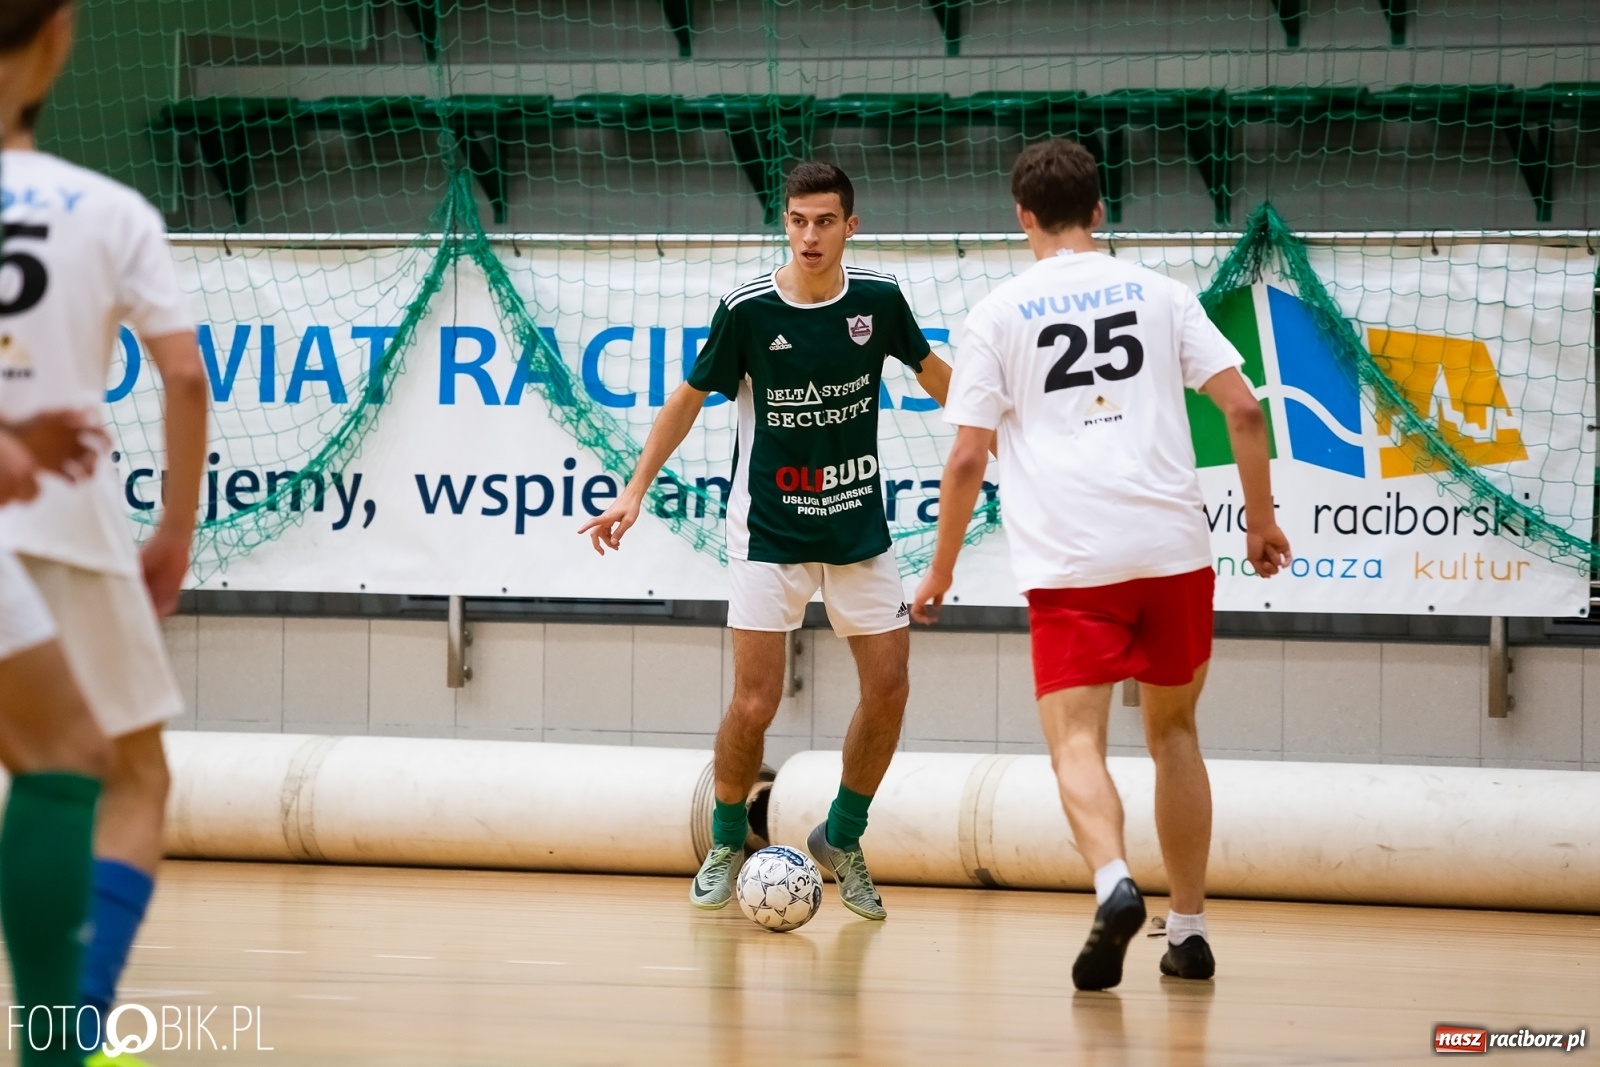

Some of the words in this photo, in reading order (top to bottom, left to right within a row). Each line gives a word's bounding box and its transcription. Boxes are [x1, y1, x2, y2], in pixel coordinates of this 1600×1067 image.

[1018, 282, 1145, 320] WUWER
[769, 343, 792, 351] adidas
[1037, 311, 1144, 394] 25
[766, 397, 872, 428] SECURITY
[775, 455, 878, 493] OLIBUD
[797, 506, 828, 516] PIOTR
[1314, 491, 1531, 537] raciborski
[1291, 557, 1383, 579] oaza
[1414, 552, 1532, 581] kultur
